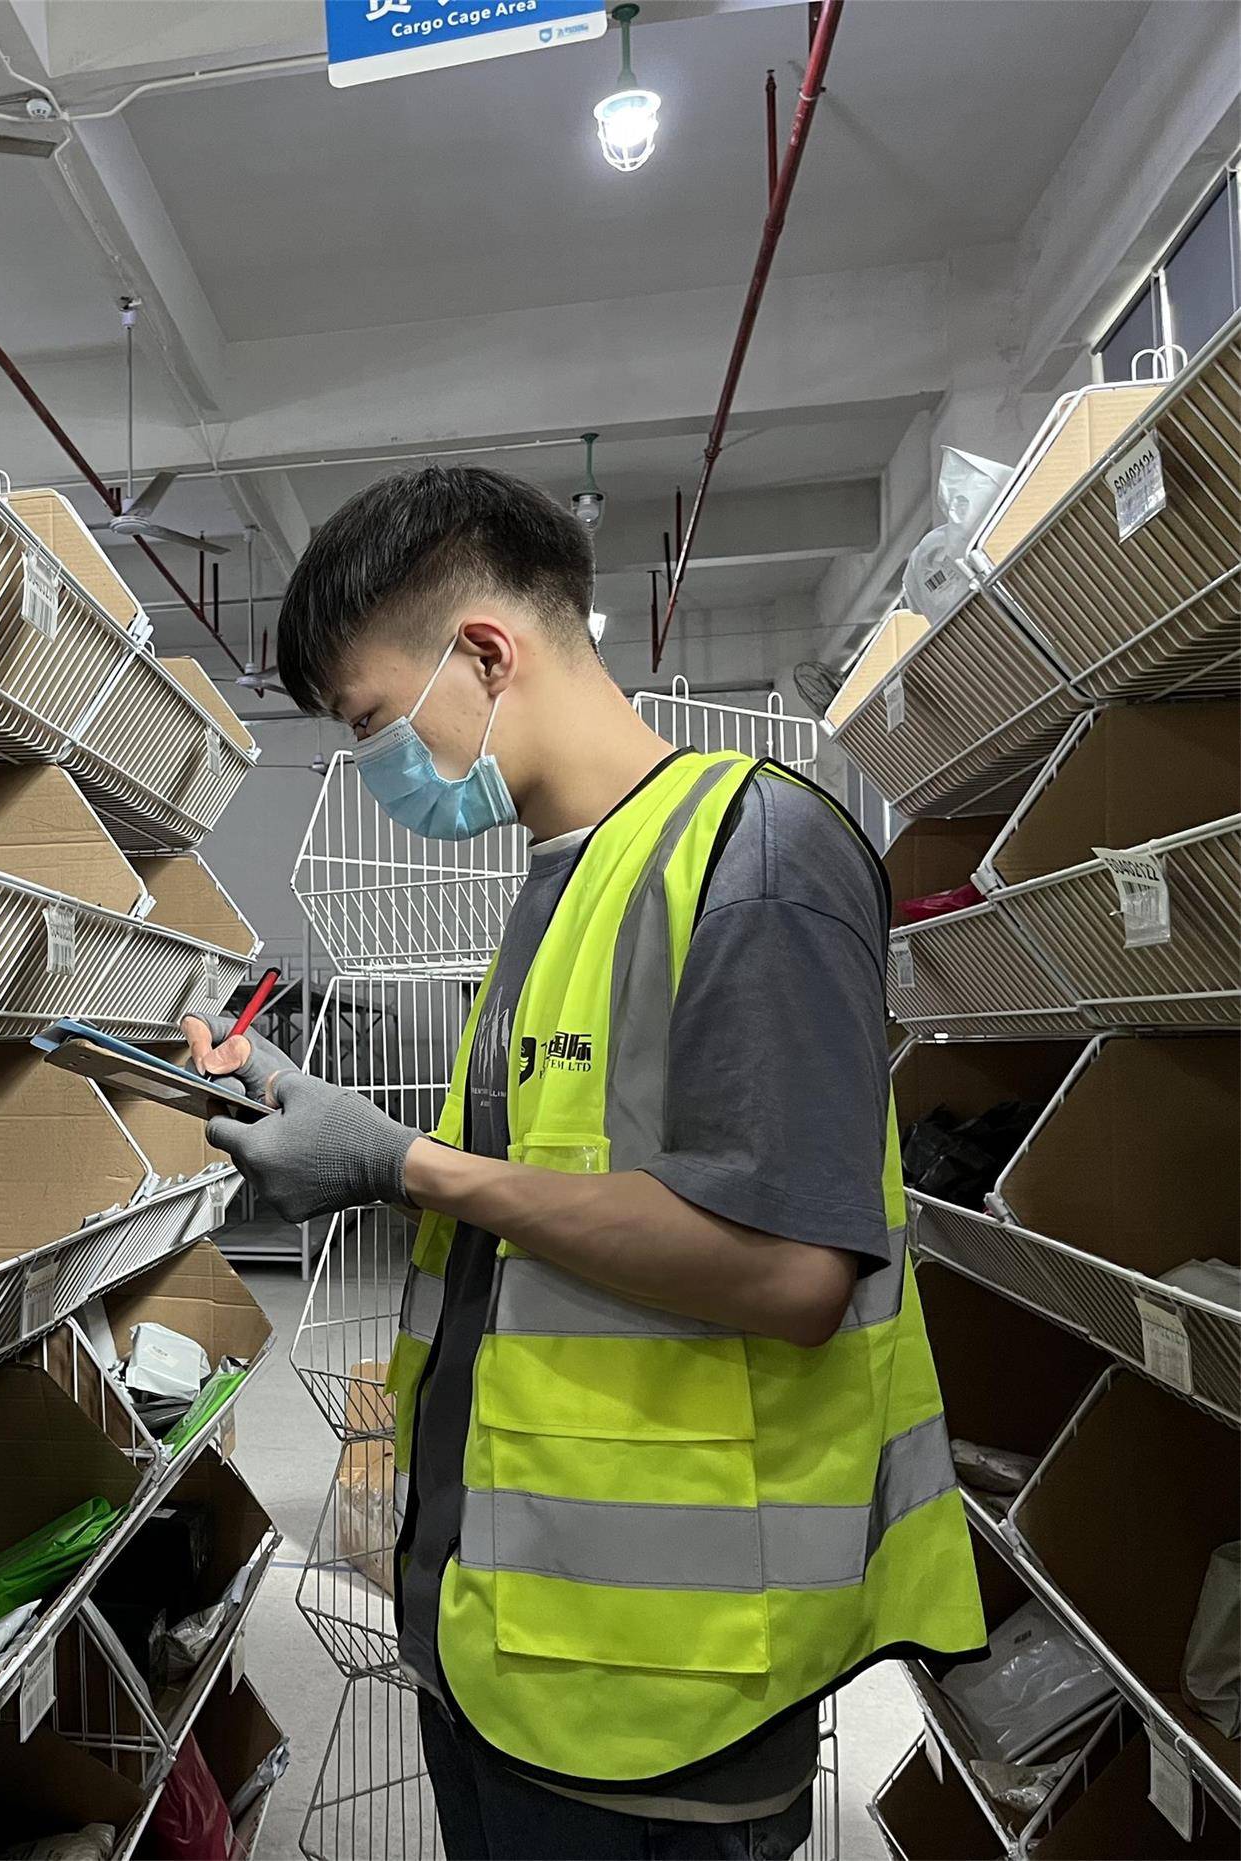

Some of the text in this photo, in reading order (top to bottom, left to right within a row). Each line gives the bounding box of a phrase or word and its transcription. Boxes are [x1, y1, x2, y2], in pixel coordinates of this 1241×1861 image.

[391, 0, 537, 37] Cargo Cage Area
[568, 1062, 592, 1072] LTD
